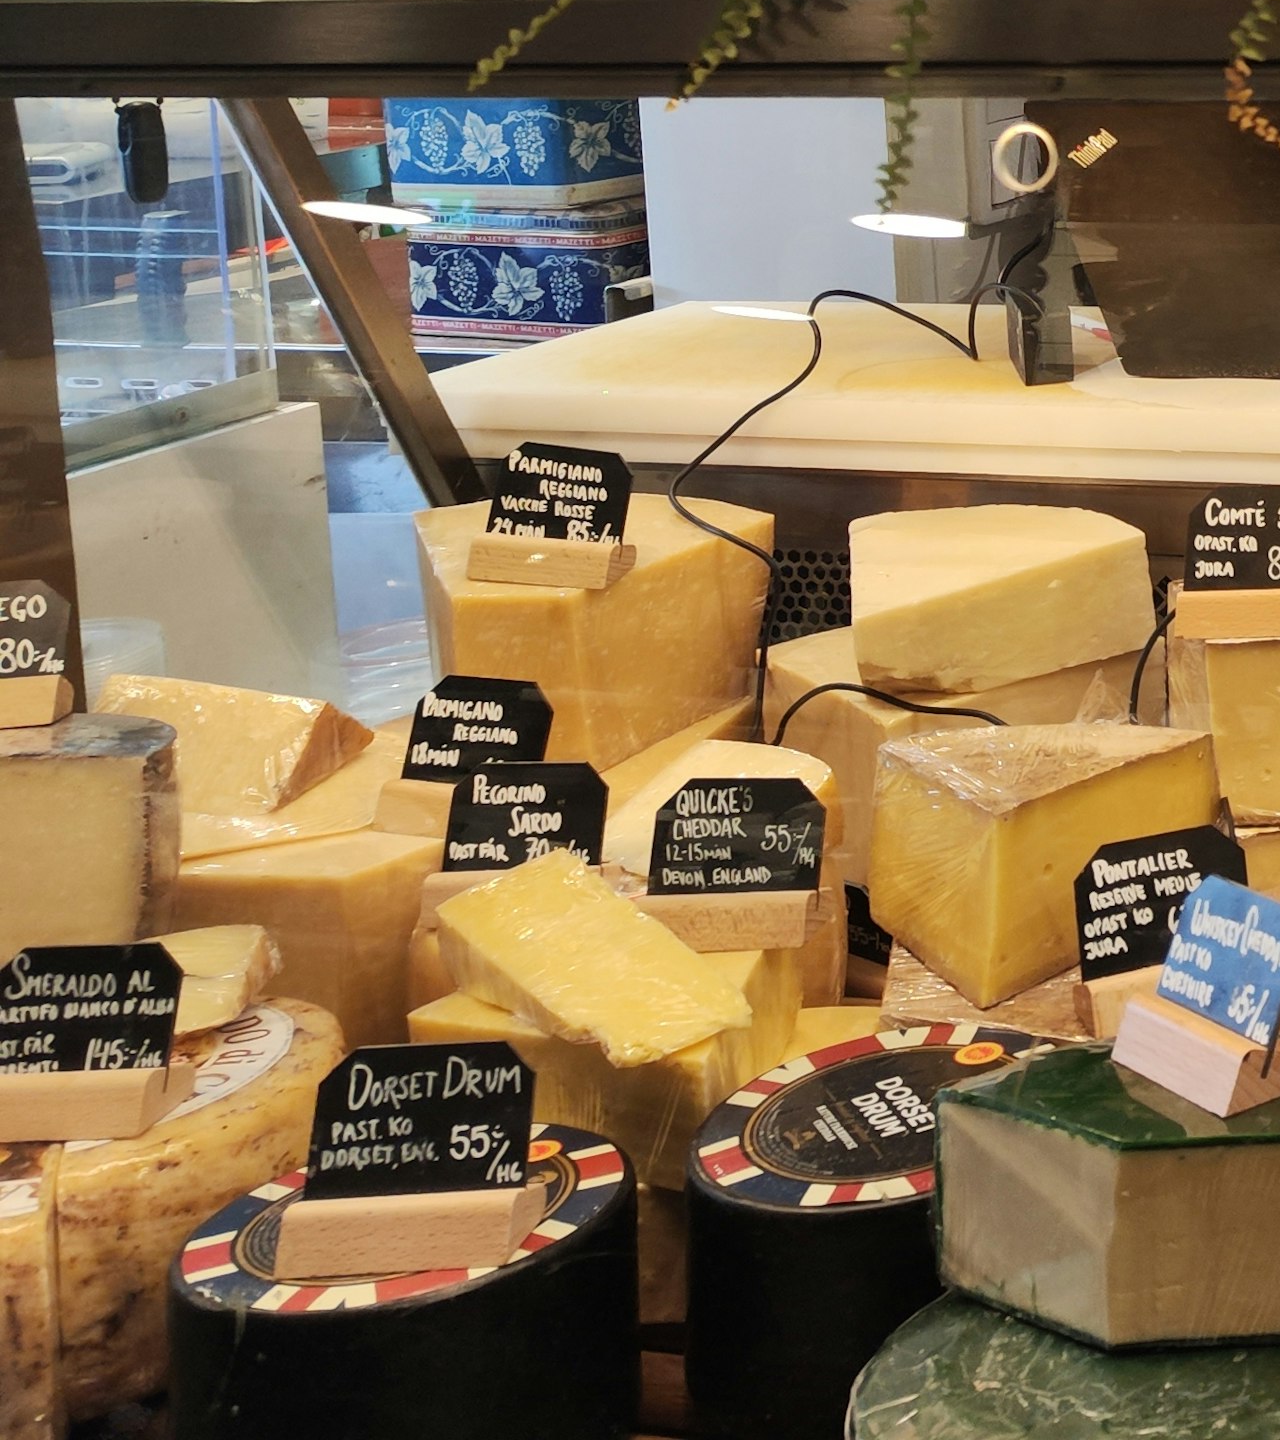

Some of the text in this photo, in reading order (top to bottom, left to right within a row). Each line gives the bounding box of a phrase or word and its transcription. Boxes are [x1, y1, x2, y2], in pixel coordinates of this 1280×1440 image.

[1067, 127, 1118, 168] ThinkPad
[474, 235, 511, 243] MAZETTI
[481, 323, 517, 331] MAZETTI
[509, 450, 602, 483] PARMIGIANO
[540, 479, 608, 502] REGGIANO
[554, 501, 595, 520] ROSSE
[1205, 498, 1266, 528] COMTÉ
[1194, 560, 1234, 579] JURA
[472, 774, 546, 805] PECORINO
[676, 785, 753, 817] QUICKE'S
[508, 806, 562, 837] SARDO
[673, 817, 747, 840] CHEDDAR
[1084, 936, 1128, 961] JURA
[348, 1055, 521, 1110] DORSET DRUM
[851, 1093, 908, 1138] DRUM
